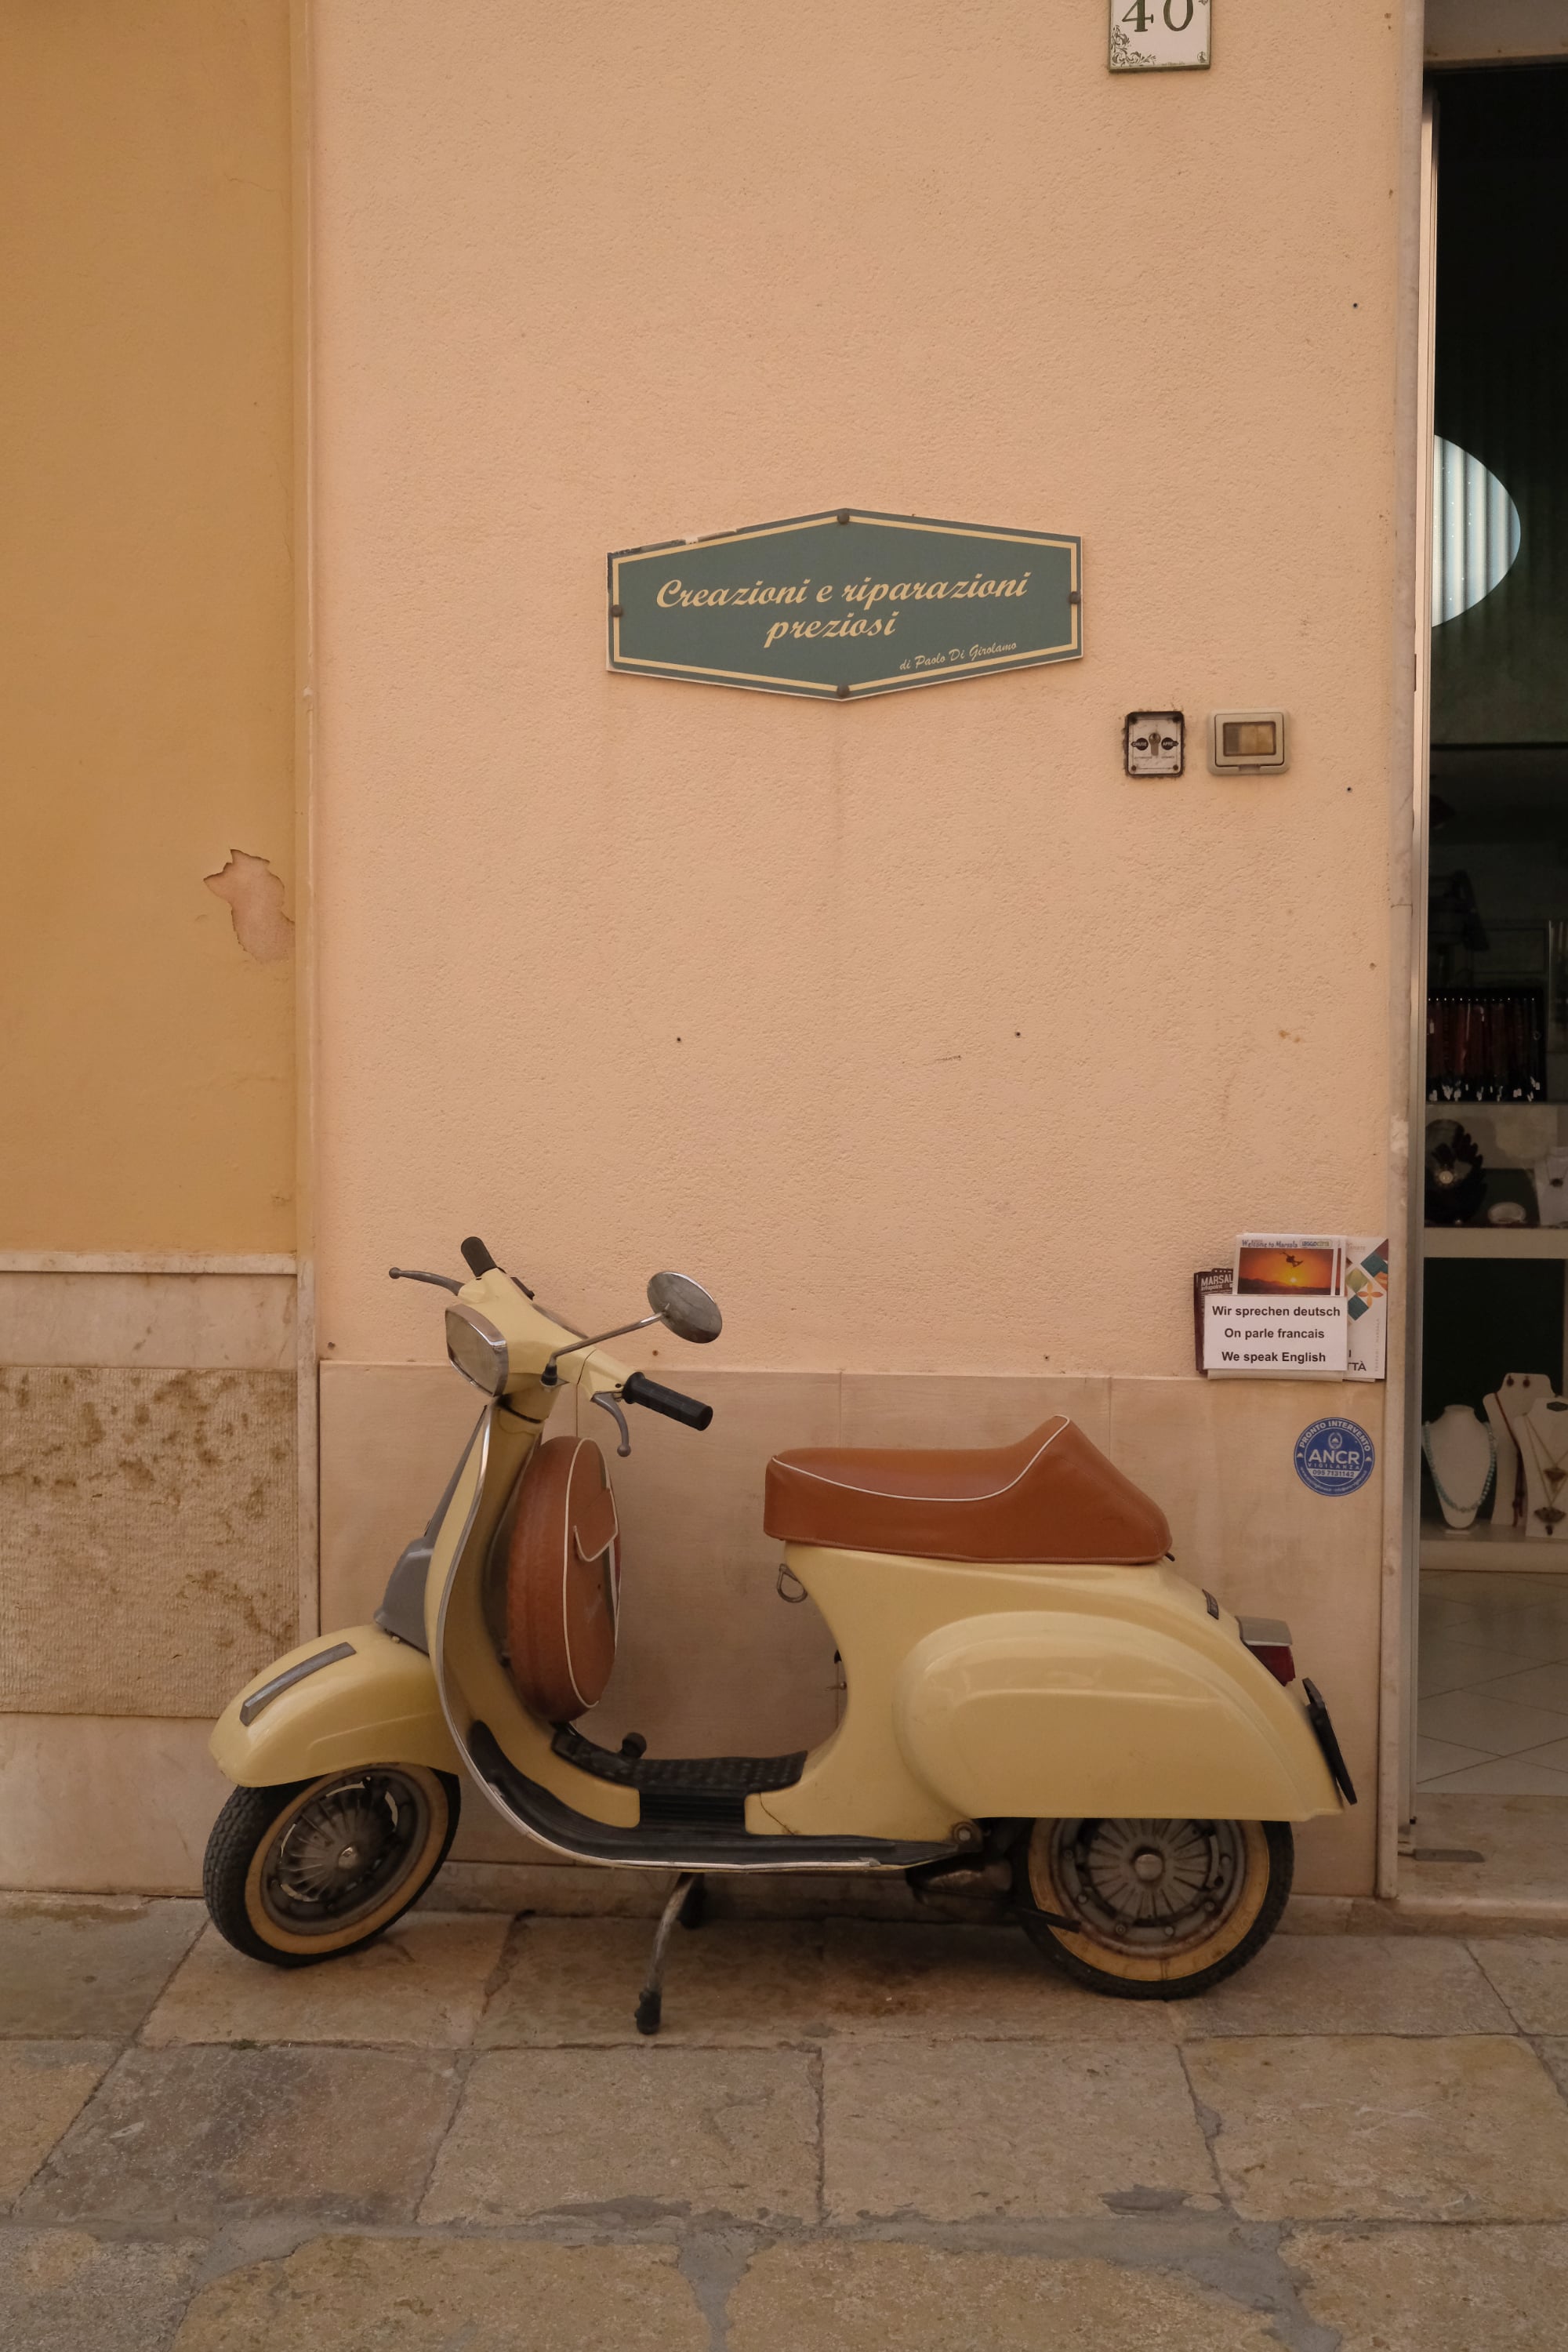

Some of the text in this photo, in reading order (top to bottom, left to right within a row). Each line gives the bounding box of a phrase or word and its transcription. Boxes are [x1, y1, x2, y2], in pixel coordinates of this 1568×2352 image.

[1122, 0, 1193, 32] 40
[656, 572, 1031, 610] Creazioni e riparazioni
[764, 611, 899, 648] preziosi
[899, 642, 1017, 670] di Paolo Di Girolamo
[1212, 1305, 1341, 1318] Wir sprechen deutsch
[1224, 1328, 1325, 1340] On parle francais
[1221, 1352, 1326, 1364] We speak English
[1299, 1421, 1371, 1452] PRONTO INTERVENTO
[1308, 1449, 1360, 1465] ANCR
